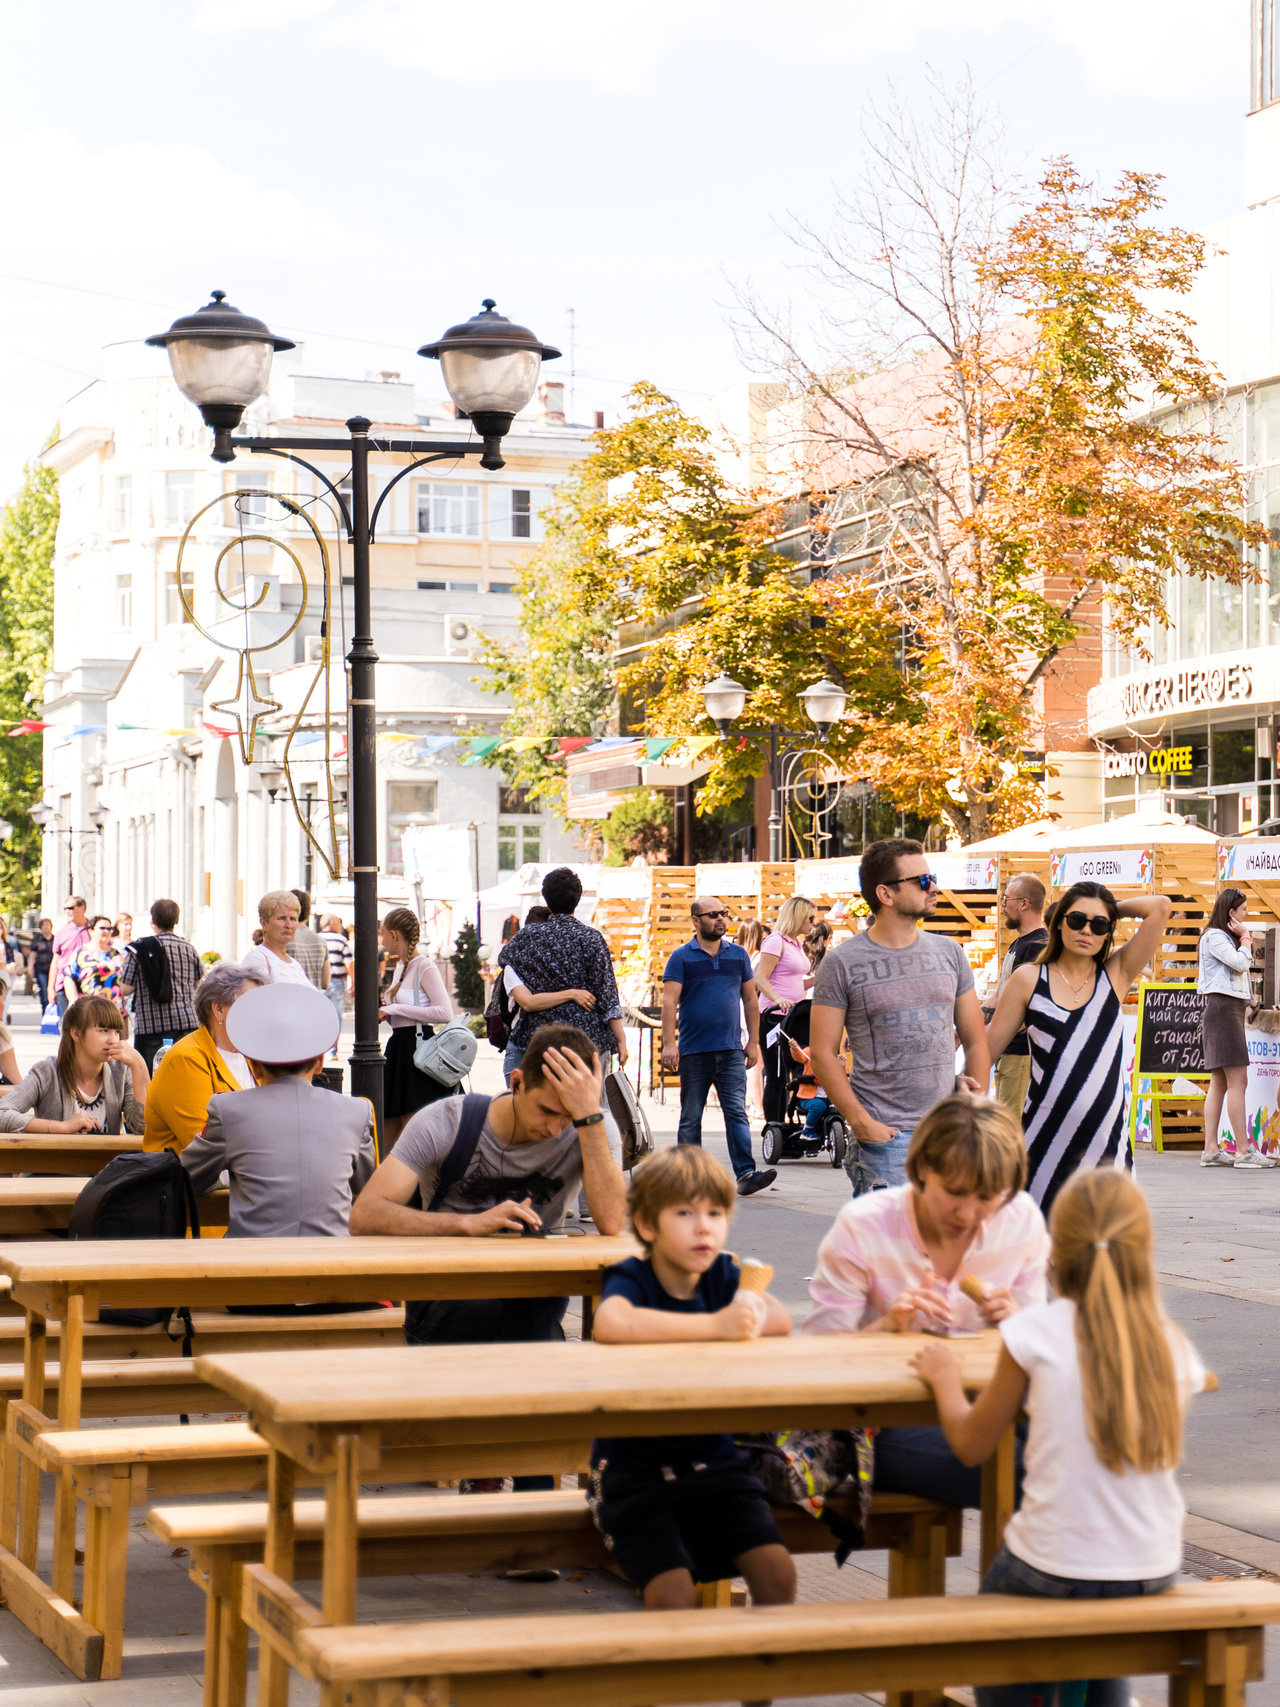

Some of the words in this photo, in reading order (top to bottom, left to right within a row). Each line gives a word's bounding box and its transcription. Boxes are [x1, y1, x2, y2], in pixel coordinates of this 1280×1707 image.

[1178, 664, 1253, 707] HEROES
[1104, 751, 1148, 779] CORTO
[1149, 746, 1193, 774] COFFEE
[1079, 861, 1094, 876] «GO
[1096, 860, 1122, 875] GREEN»
[848, 951, 952, 986] SUPER
[1145, 990, 1208, 1008] КИТАЙСКИ
[1256, 1067, 1269, 1078] ДЕНЬ
